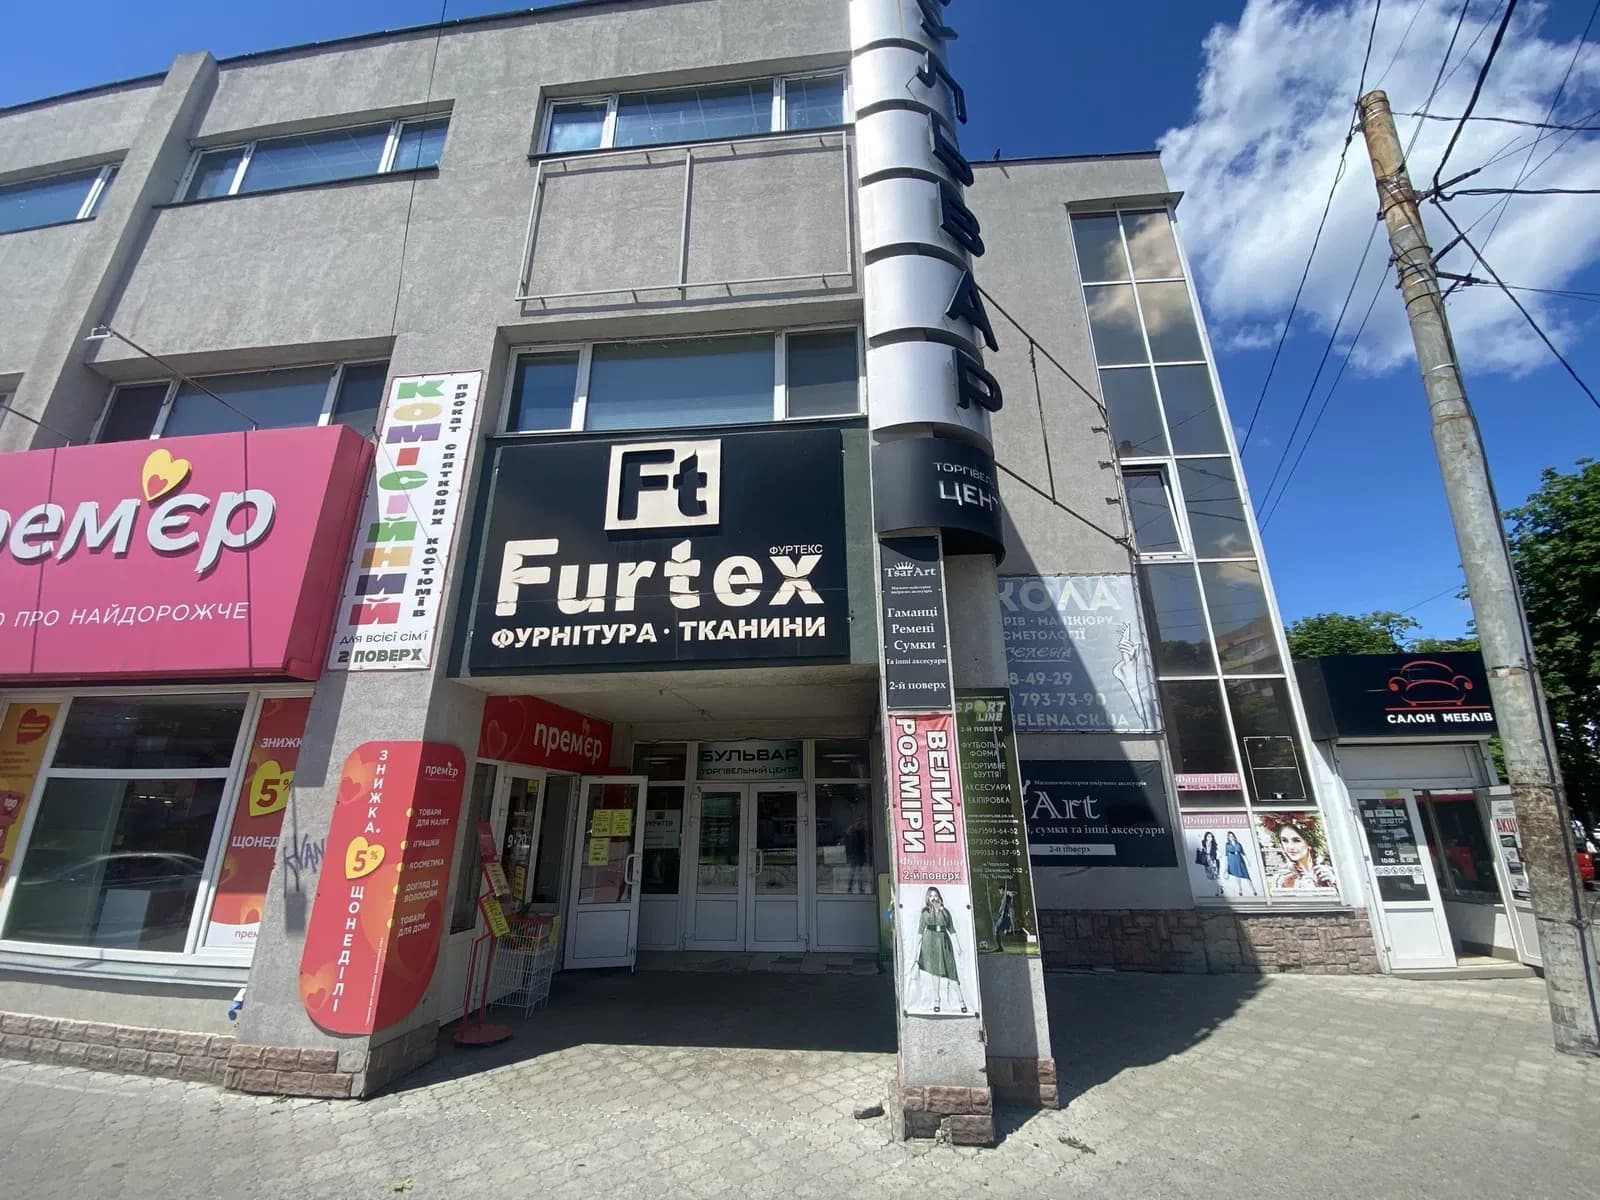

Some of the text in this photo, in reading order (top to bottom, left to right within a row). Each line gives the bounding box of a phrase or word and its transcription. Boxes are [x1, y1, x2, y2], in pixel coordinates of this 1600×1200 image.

[617, 448, 708, 521] Ft
[349, 380, 445, 625] КОМІСІЙНИЙ
[769, 544, 823, 556] ФУРТЕКС
[495, 539, 825, 617] Furtex
[15, 610, 60, 628] ПРО
[70, 602, 249, 626] НАЙДОРОЖЧЕ
[888, 607, 938, 619] Гаманці
[1040, 615, 1113, 626] МАНІКЮРУ
[492, 616, 825, 648] ФУРНІТУРА ТКАНИНИ
[891, 623, 935, 634] Ремені
[894, 640, 936, 653] Сумки
[338, 648, 423, 664] 2 ПОВЕРХ
[889, 681, 946, 692] 2-й поверх
[976, 712, 1003, 722] LINE
[1013, 713, 1129, 726] ELENA.CK.UA
[1387, 712, 1493, 723] САЛОН МЕБЛІВ
[701, 749, 799, 762] БУЛЬВАР
[700, 765, 798, 776] ТОРГІВЕЛЬНИЙ ЦЕНТР
[896, 718, 926, 854] РОЗМІРИ
[926, 729, 957, 843] ВЕЛИКІ
[1036, 826, 1068, 837] сумки
[1085, 825, 1109, 834] інші
[1111, 827, 1166, 838] аксесуари
[353, 850, 379, 872] 5%
[409, 859, 445, 870] КОСМЕТИКА
[904, 870, 960, 883] 2-й поверх
[333, 886, 364, 1012] ЩОНЕДІЛІ
